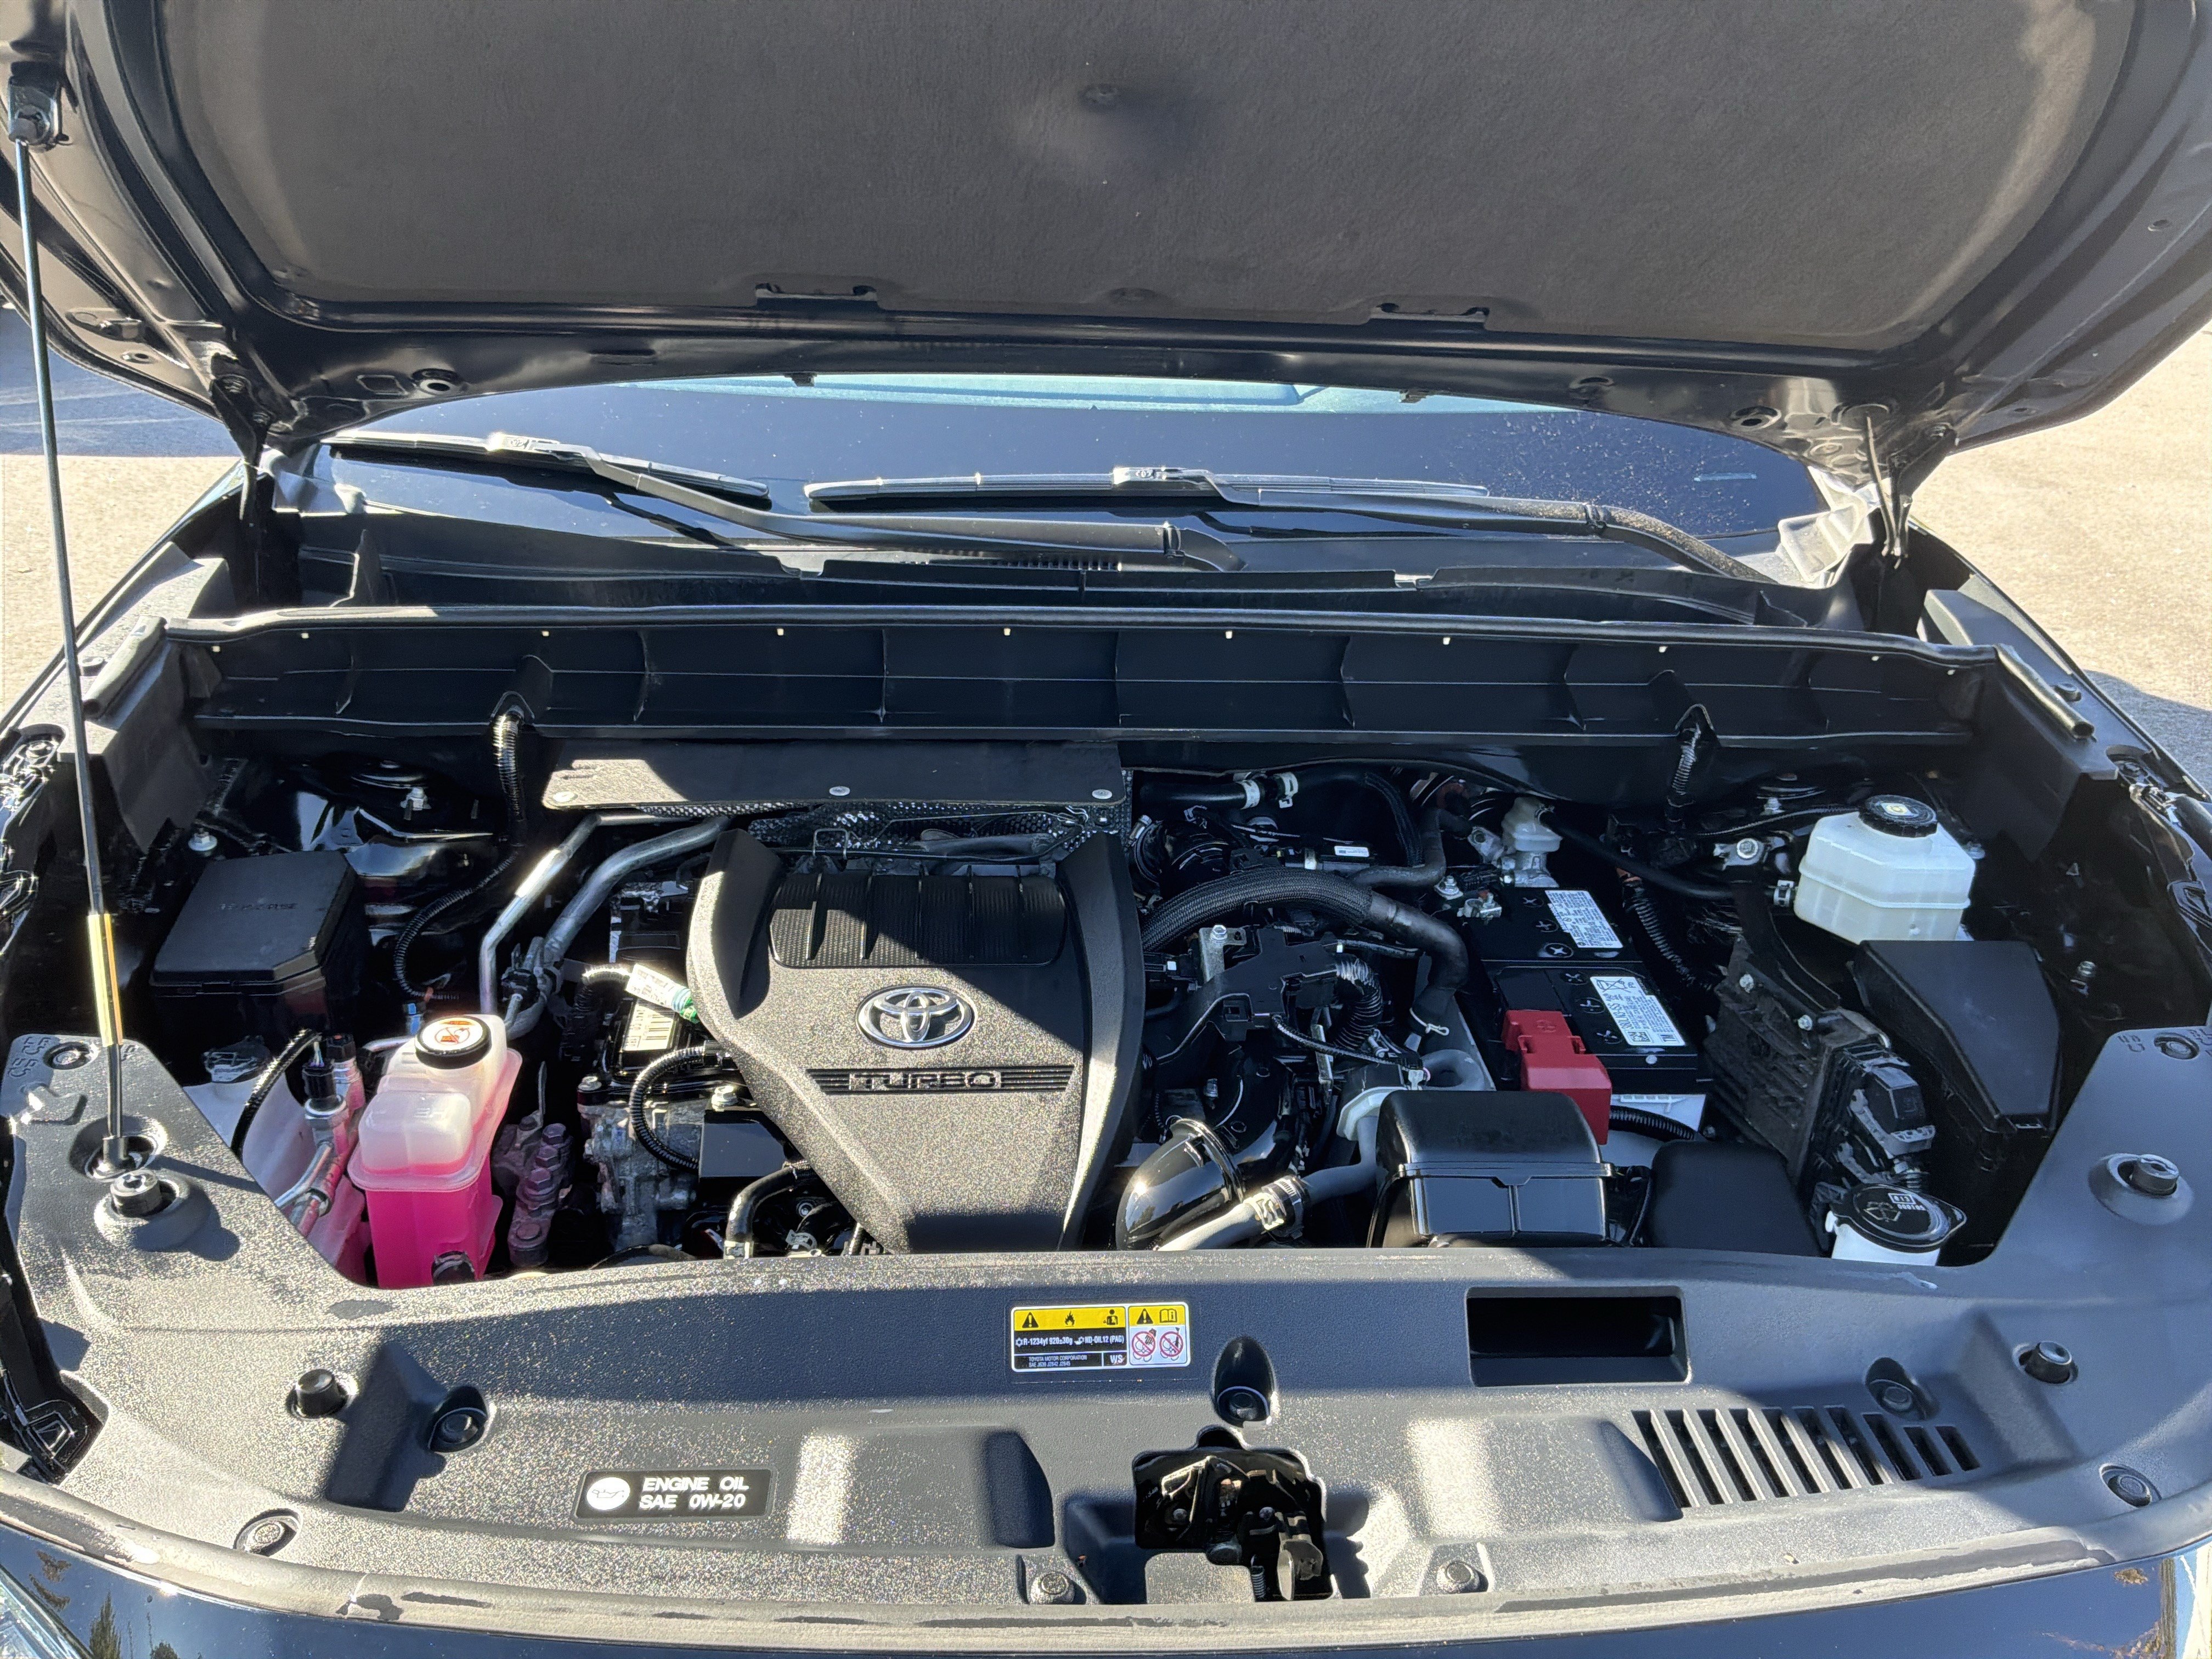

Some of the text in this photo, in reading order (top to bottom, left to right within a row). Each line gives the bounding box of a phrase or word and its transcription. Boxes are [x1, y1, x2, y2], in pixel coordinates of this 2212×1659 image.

[850, 1071, 1001, 1090] TURBO
[1023, 1337, 1048, 1346] R-1234yf
[1049, 1336, 1073, 1346] 920±30g
[1110, 1335, 1125, 1344] (PAG)
[1110, 1355, 1124, 1364] WS
[642, 1476, 749, 1491] ENGINE OIL
[639, 1493, 746, 1509] SAE 0W-20
